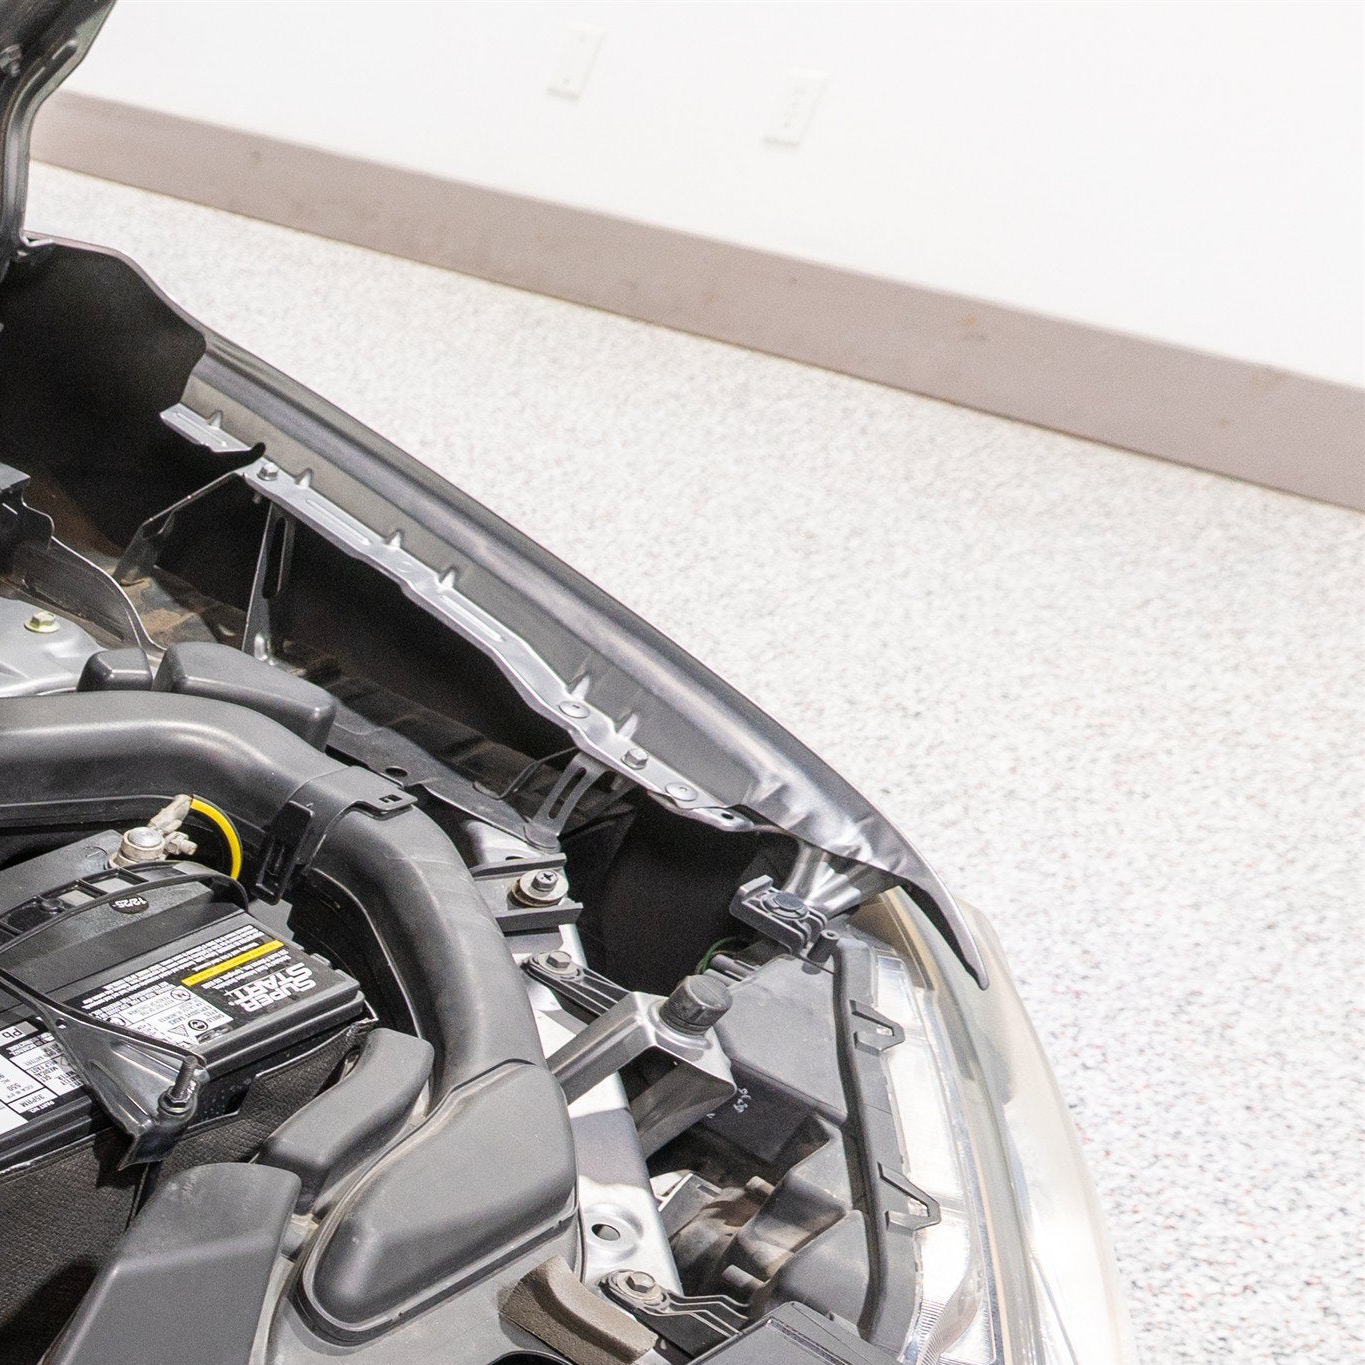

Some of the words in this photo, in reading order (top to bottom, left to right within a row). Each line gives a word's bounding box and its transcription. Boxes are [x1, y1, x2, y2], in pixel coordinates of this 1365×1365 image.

[235, 962, 315, 1005] START
[239, 975, 317, 1014] SUPER
[0, 1027, 23, 1040] Pb
